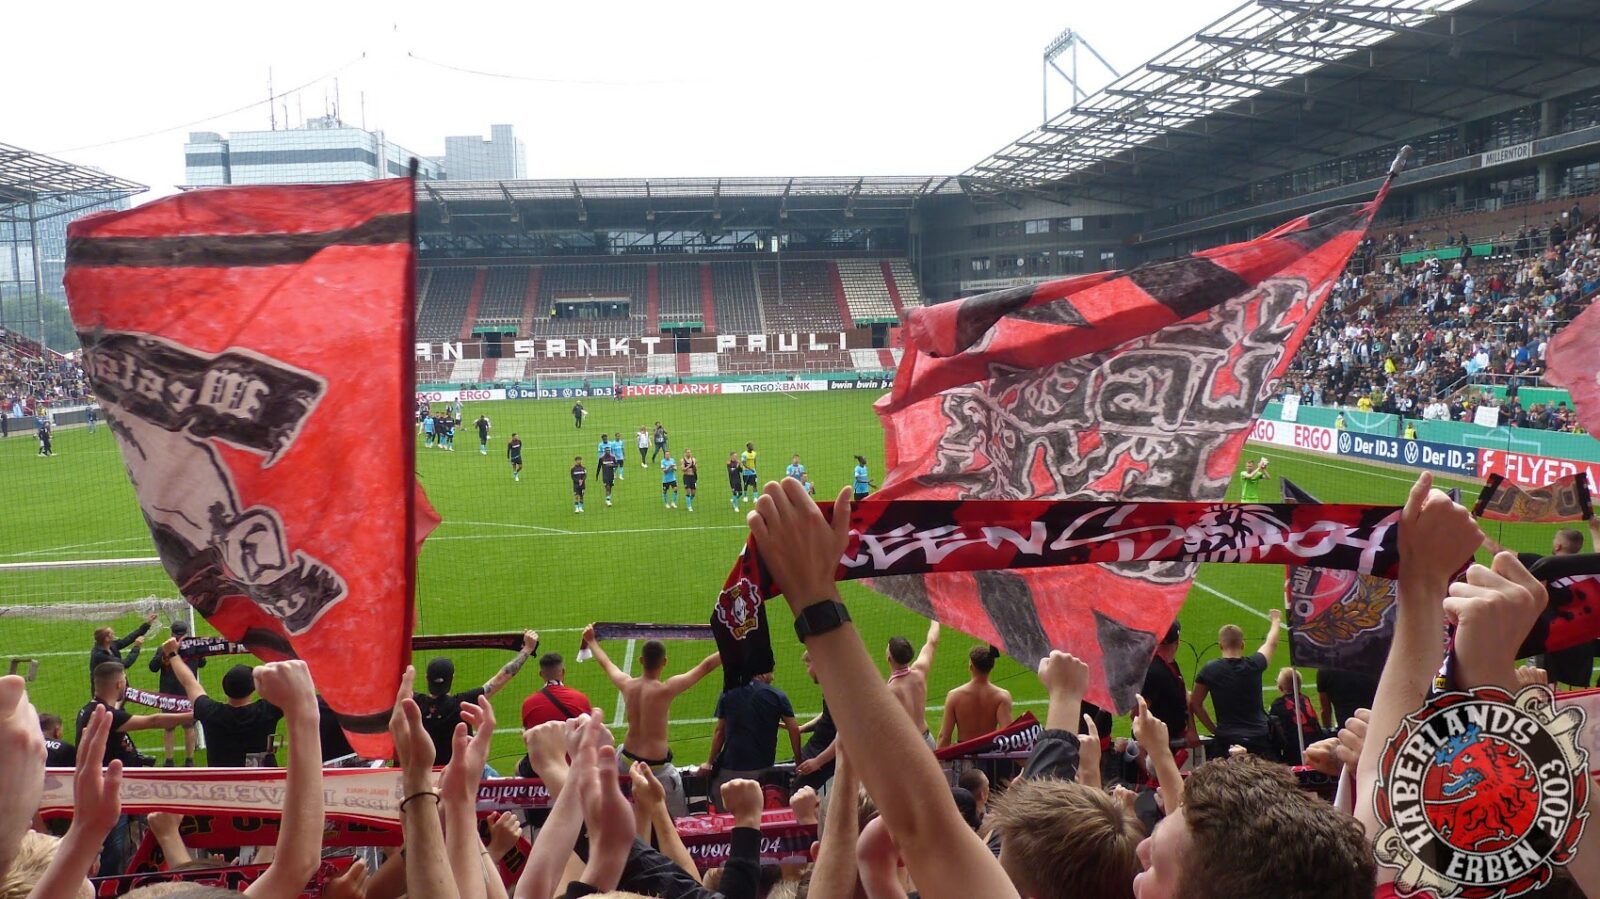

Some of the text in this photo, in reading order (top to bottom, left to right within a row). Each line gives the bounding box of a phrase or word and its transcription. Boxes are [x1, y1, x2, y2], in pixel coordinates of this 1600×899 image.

[1486, 145, 1528, 163] MILLERNTOR
[415, 333, 846, 361] AN SANKT PAULI
[627, 384, 709, 396] FLYERALARM
[831, 381, 853, 389] bwin
[856, 380, 878, 389] bwin
[416, 390, 491, 401] RGO ERGO
[1252, 420, 1331, 450] RGO ERGO
[1354, 436, 1374, 455] Der
[1375, 439, 1398, 459] ID.3
[1422, 446, 1445, 466] Der
